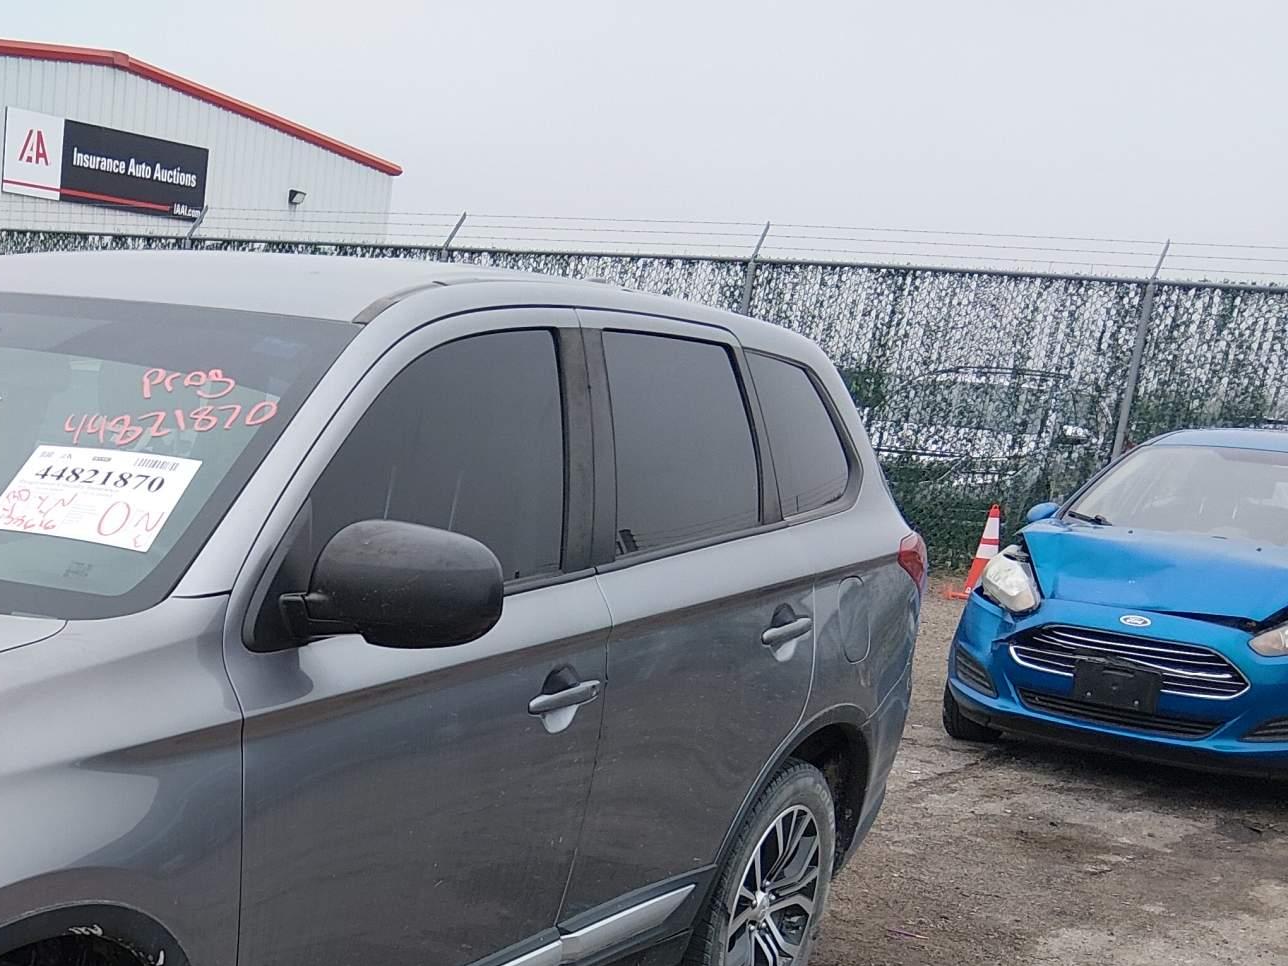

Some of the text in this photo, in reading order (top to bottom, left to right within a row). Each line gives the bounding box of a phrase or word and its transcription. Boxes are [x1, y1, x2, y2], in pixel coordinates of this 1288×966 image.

[73, 147, 197, 187] Insurance Auto Auctions
[64, 401, 279, 446] 44821870
[34, 464, 165, 493] 44821870
